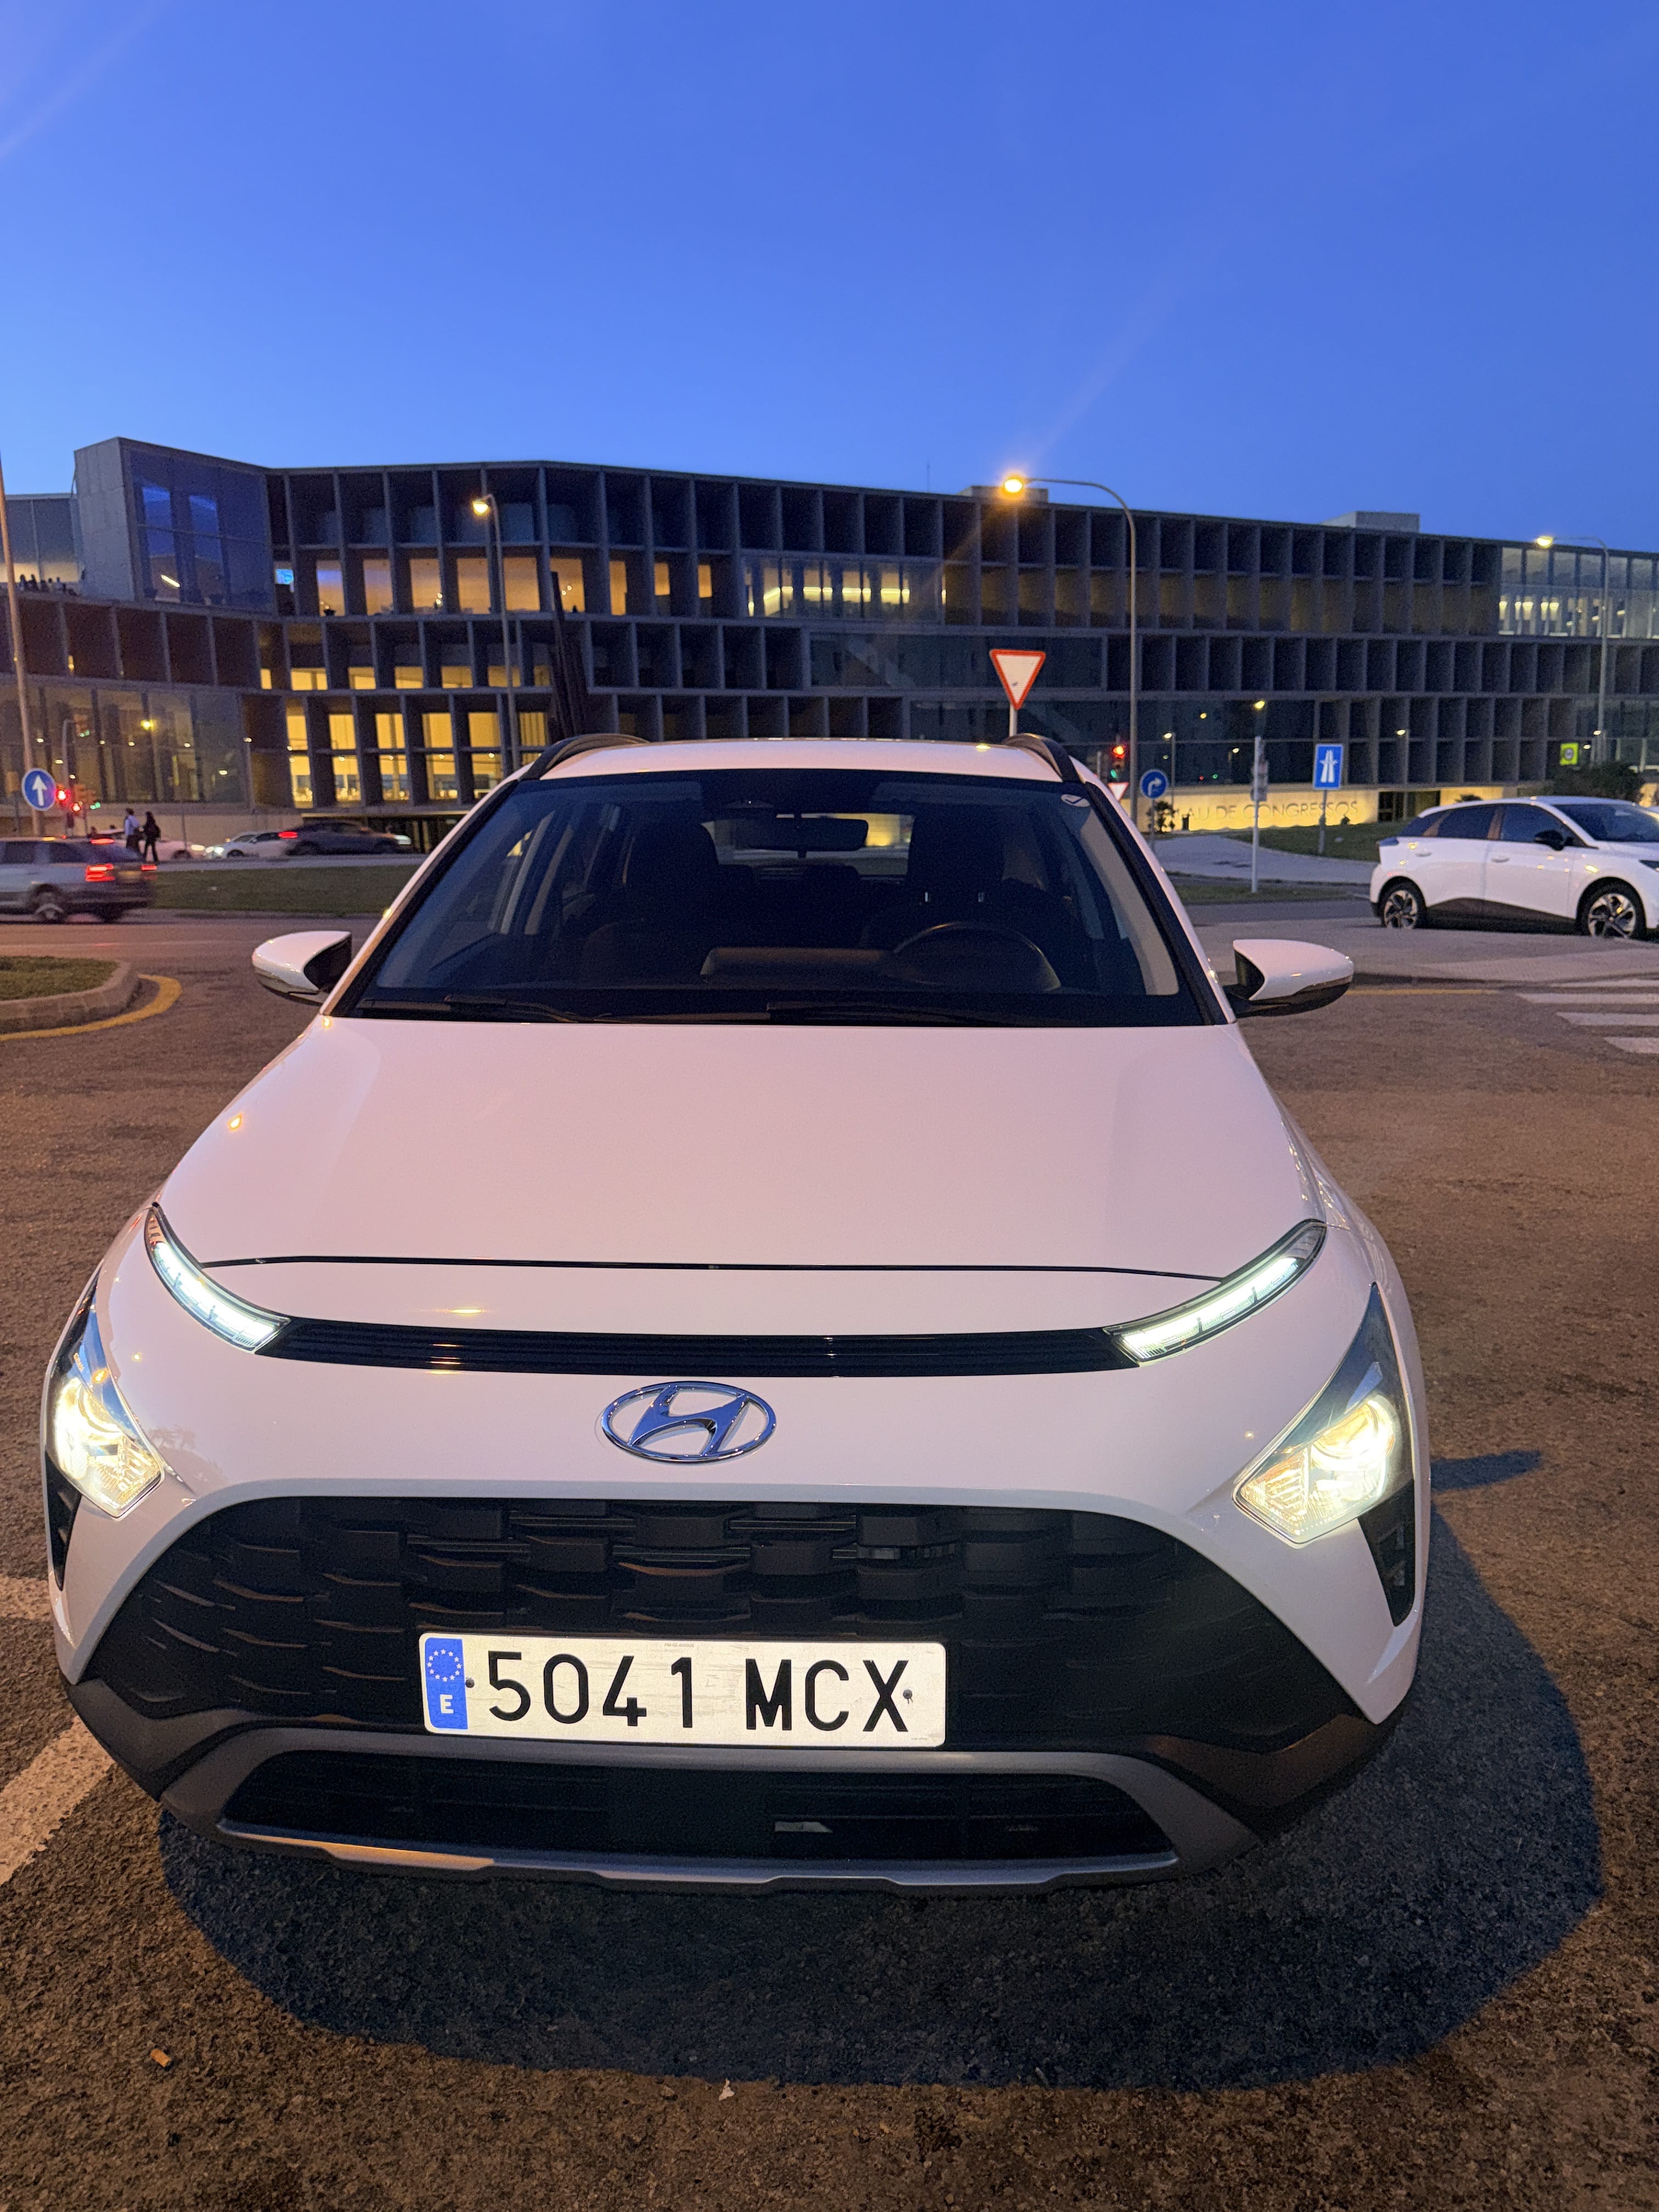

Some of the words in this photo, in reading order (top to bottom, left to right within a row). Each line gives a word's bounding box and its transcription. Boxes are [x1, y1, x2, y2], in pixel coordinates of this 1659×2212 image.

[1215, 805, 1237, 819] DE
[488, 1651, 693, 1728] 5041
[746, 1658, 909, 1732] MCX
[439, 1694, 454, 1714] E
